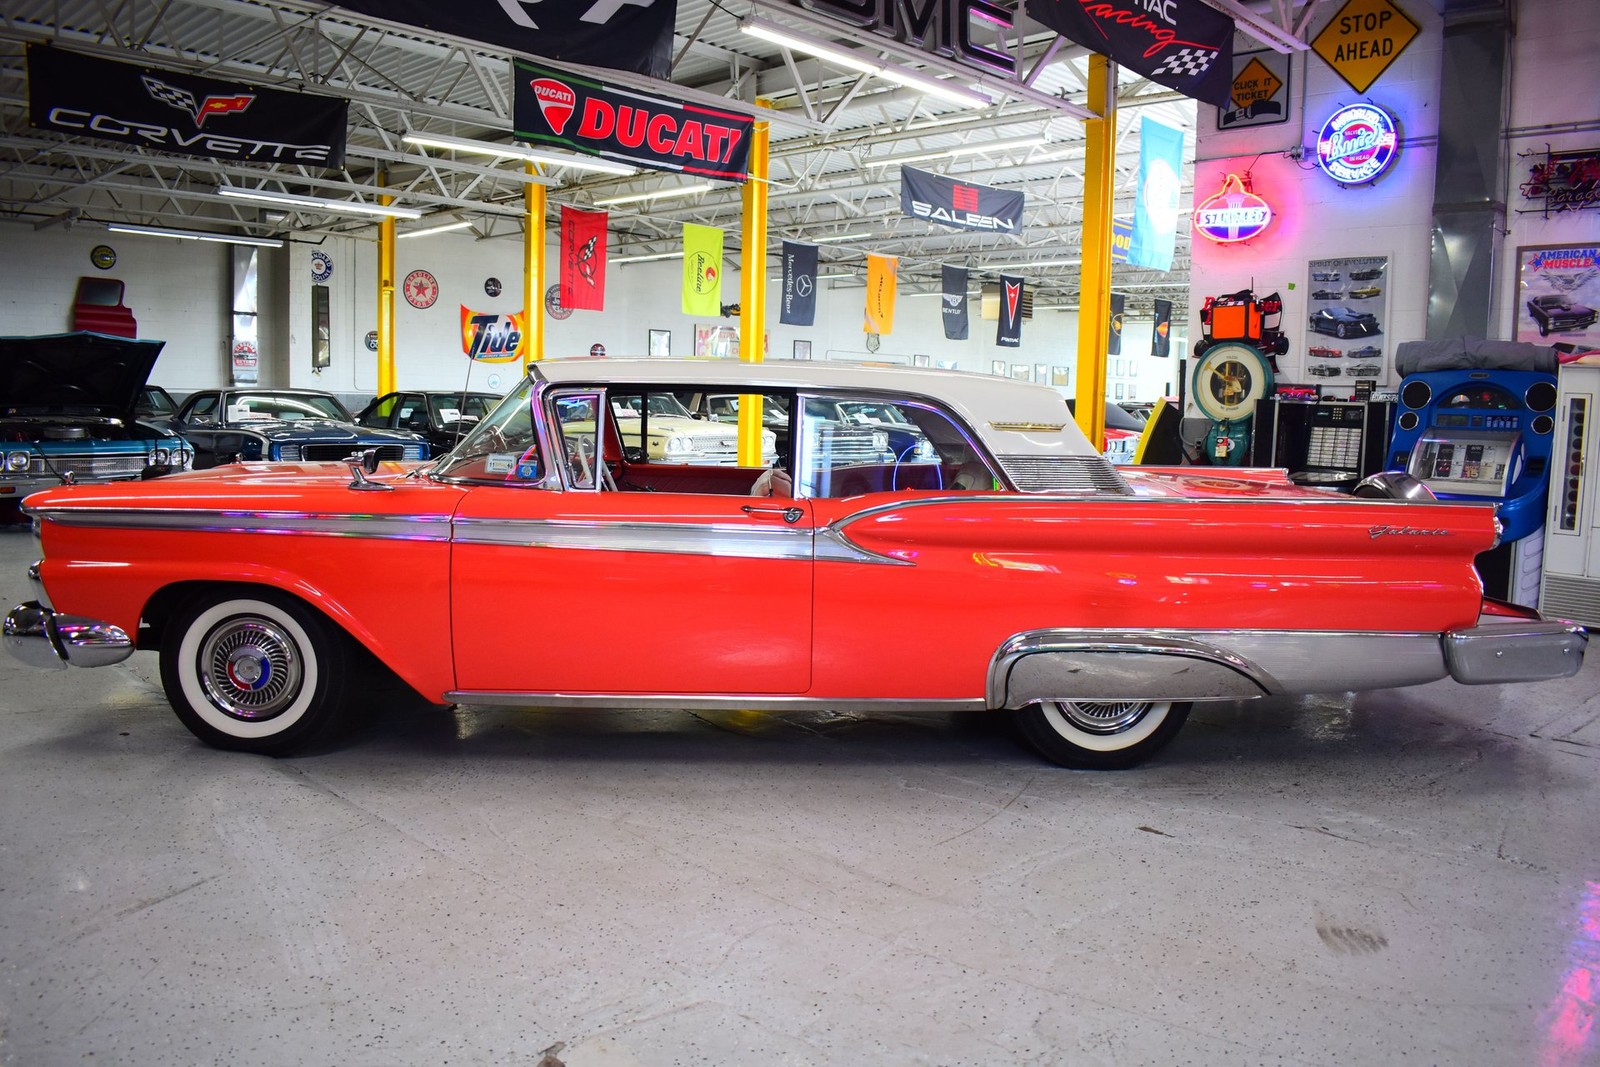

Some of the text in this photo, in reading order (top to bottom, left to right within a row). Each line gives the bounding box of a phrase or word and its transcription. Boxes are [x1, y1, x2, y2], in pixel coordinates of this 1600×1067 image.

[1340, 10, 1392, 35] STOP
[1334, 38, 1393, 62] AHEAD
[534, 84, 571, 102] DUCATI
[1233, 77, 1272, 91] CLICK IT
[1236, 90, 1268, 101] TICKET
[49, 107, 331, 160] CORVETTE
[576, 97, 742, 164] DUCATI
[1329, 158, 1381, 180] SERVICE
[912, 200, 1014, 230] SALEEN
[1309, 260, 1333, 268] SPIRIT
[1344, 256, 1388, 267] EVOLUTION
[1540, 249, 1597, 260] AMERICAN
[1543, 258, 1593, 269] MUSCLE
[786, 253, 795, 314] Mercedes-Benz
[468, 314, 521, 359] Tide
[1368, 524, 1448, 539] Galaxie
